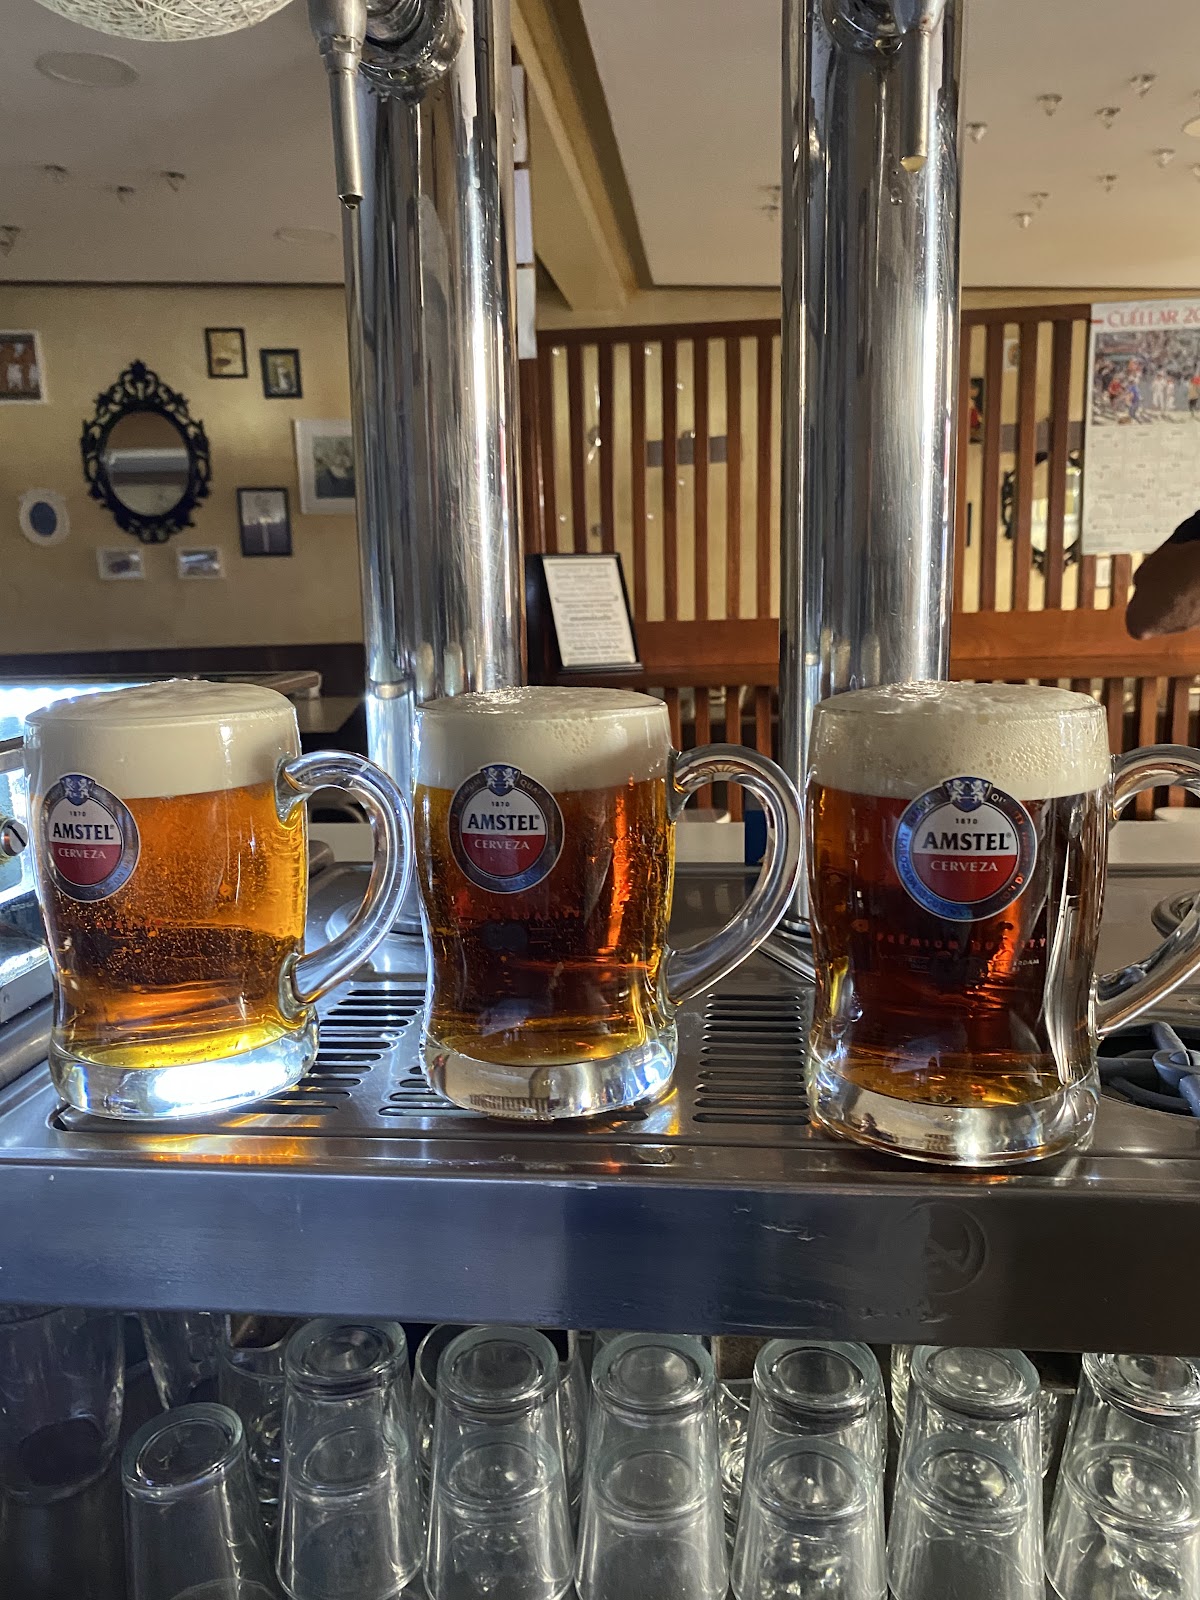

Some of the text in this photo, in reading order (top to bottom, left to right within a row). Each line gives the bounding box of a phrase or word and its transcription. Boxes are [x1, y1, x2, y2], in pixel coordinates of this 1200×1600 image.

[467, 813, 539, 831] AMSTEL
[955, 817, 978, 825] 1870
[52, 822, 114, 841] AMSTEL
[474, 839, 530, 850] CERVEZA
[922, 831, 1010, 851] AMSTEL
[58, 847, 107, 859] CERVEZA
[930, 860, 999, 872] CERVEZA
